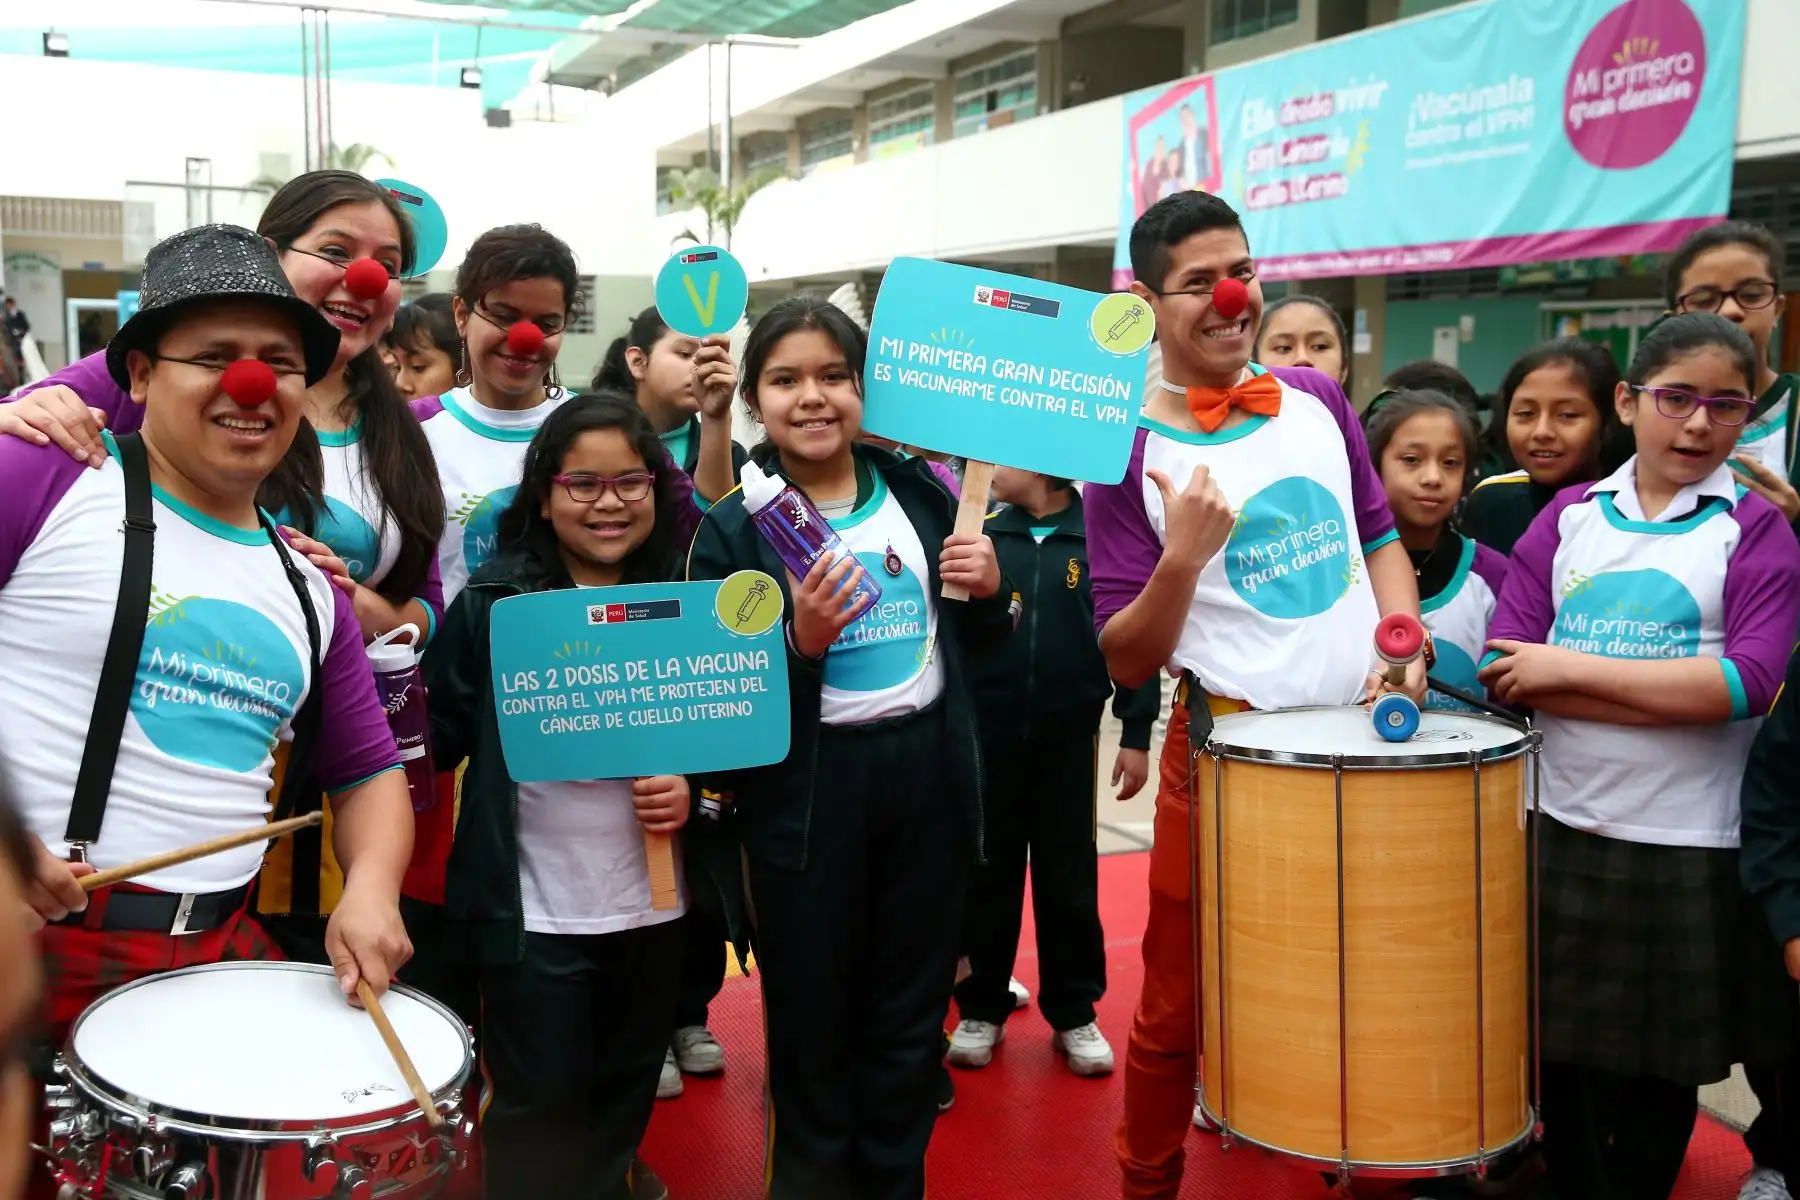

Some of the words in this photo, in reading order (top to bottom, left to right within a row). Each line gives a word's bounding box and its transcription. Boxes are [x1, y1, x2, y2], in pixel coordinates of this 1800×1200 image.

[1602, 51, 1695, 98] primera
[683, 271, 719, 327] V
[880, 336, 904, 359] MI
[908, 341, 987, 376] PRIMERA
[992, 358, 1045, 385] GRAN
[1049, 368, 1131, 401] DECISIÓN
[874, 362, 892, 382] ES
[898, 367, 996, 402] VACUNARME
[1000, 387, 1067, 415] CONTRA
[1070, 399, 1089, 419] EL
[1095, 403, 1128, 425] VPH
[1237, 544, 1265, 571] Mi
[1266, 519, 1340, 564] primera
[1242, 563, 1288, 594] gran
[1291, 539, 1345, 571] decisión
[855, 618, 920, 643] decisión
[1563, 612, 1588, 632] Mi
[1590, 616, 1687, 639] primera
[1606, 636, 1688, 658] decisión
[140, 680, 207, 708] gran
[148, 646, 186, 677] Mi
[188, 662, 290, 704] primera
[502, 670, 540, 693] LAS
[545, 668, 559, 689] 2
[564, 663, 619, 688] DOSIS
[625, 660, 649, 682] DE
[655, 657, 681, 679] LA
[686, 650, 769, 676] VACUNA
[502, 694, 568, 715] CONTRA
[571, 692, 590, 709] EL
[594, 688, 627, 706] VPH
[631, 686, 655, 702] ME
[659, 678, 736, 701] PROTEJEN
[740, 676, 768, 693] DEL
[540, 714, 601, 734] CÁNCER
[604, 712, 624, 728] DE
[628, 706, 683, 726] CUELLO
[688, 700, 753, 720] UTERINO
